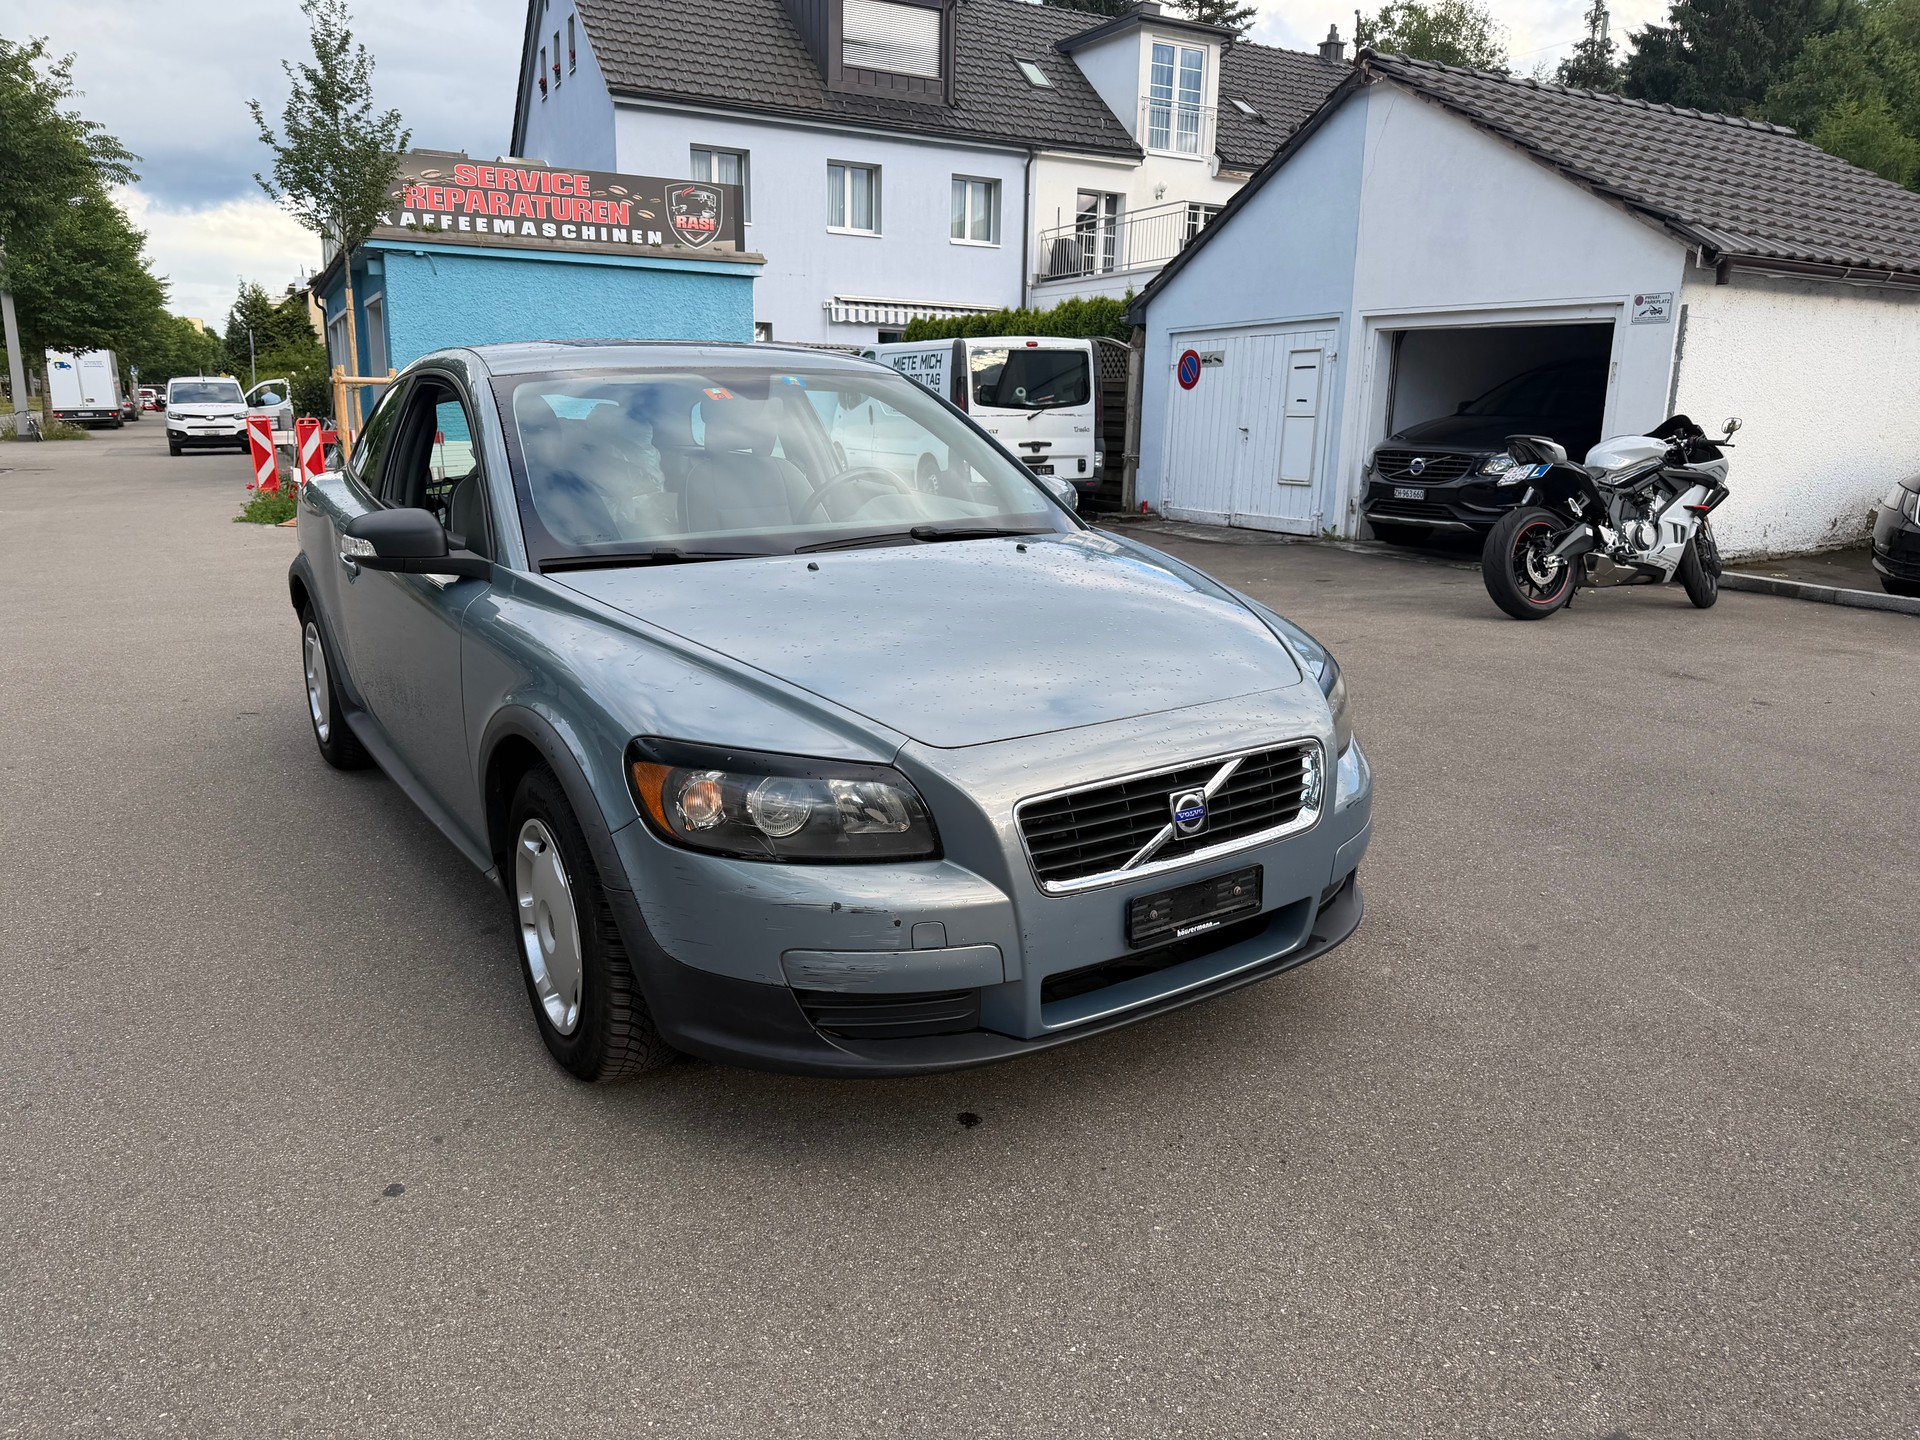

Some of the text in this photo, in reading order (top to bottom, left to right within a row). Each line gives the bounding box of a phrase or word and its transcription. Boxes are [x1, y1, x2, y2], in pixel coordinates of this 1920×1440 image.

[453, 163, 590, 197] SERVICE
[403, 183, 630, 226] REPARATUREN
[375, 211, 662, 245] KAFFEEMASCHINEN
[675, 214, 715, 231] RASI
[893, 353, 943, 371] MIETE MICH
[925, 373, 941, 386] TAG
[1530, 466, 1541, 477] L
[1178, 808, 1204, 819] VOLVO
